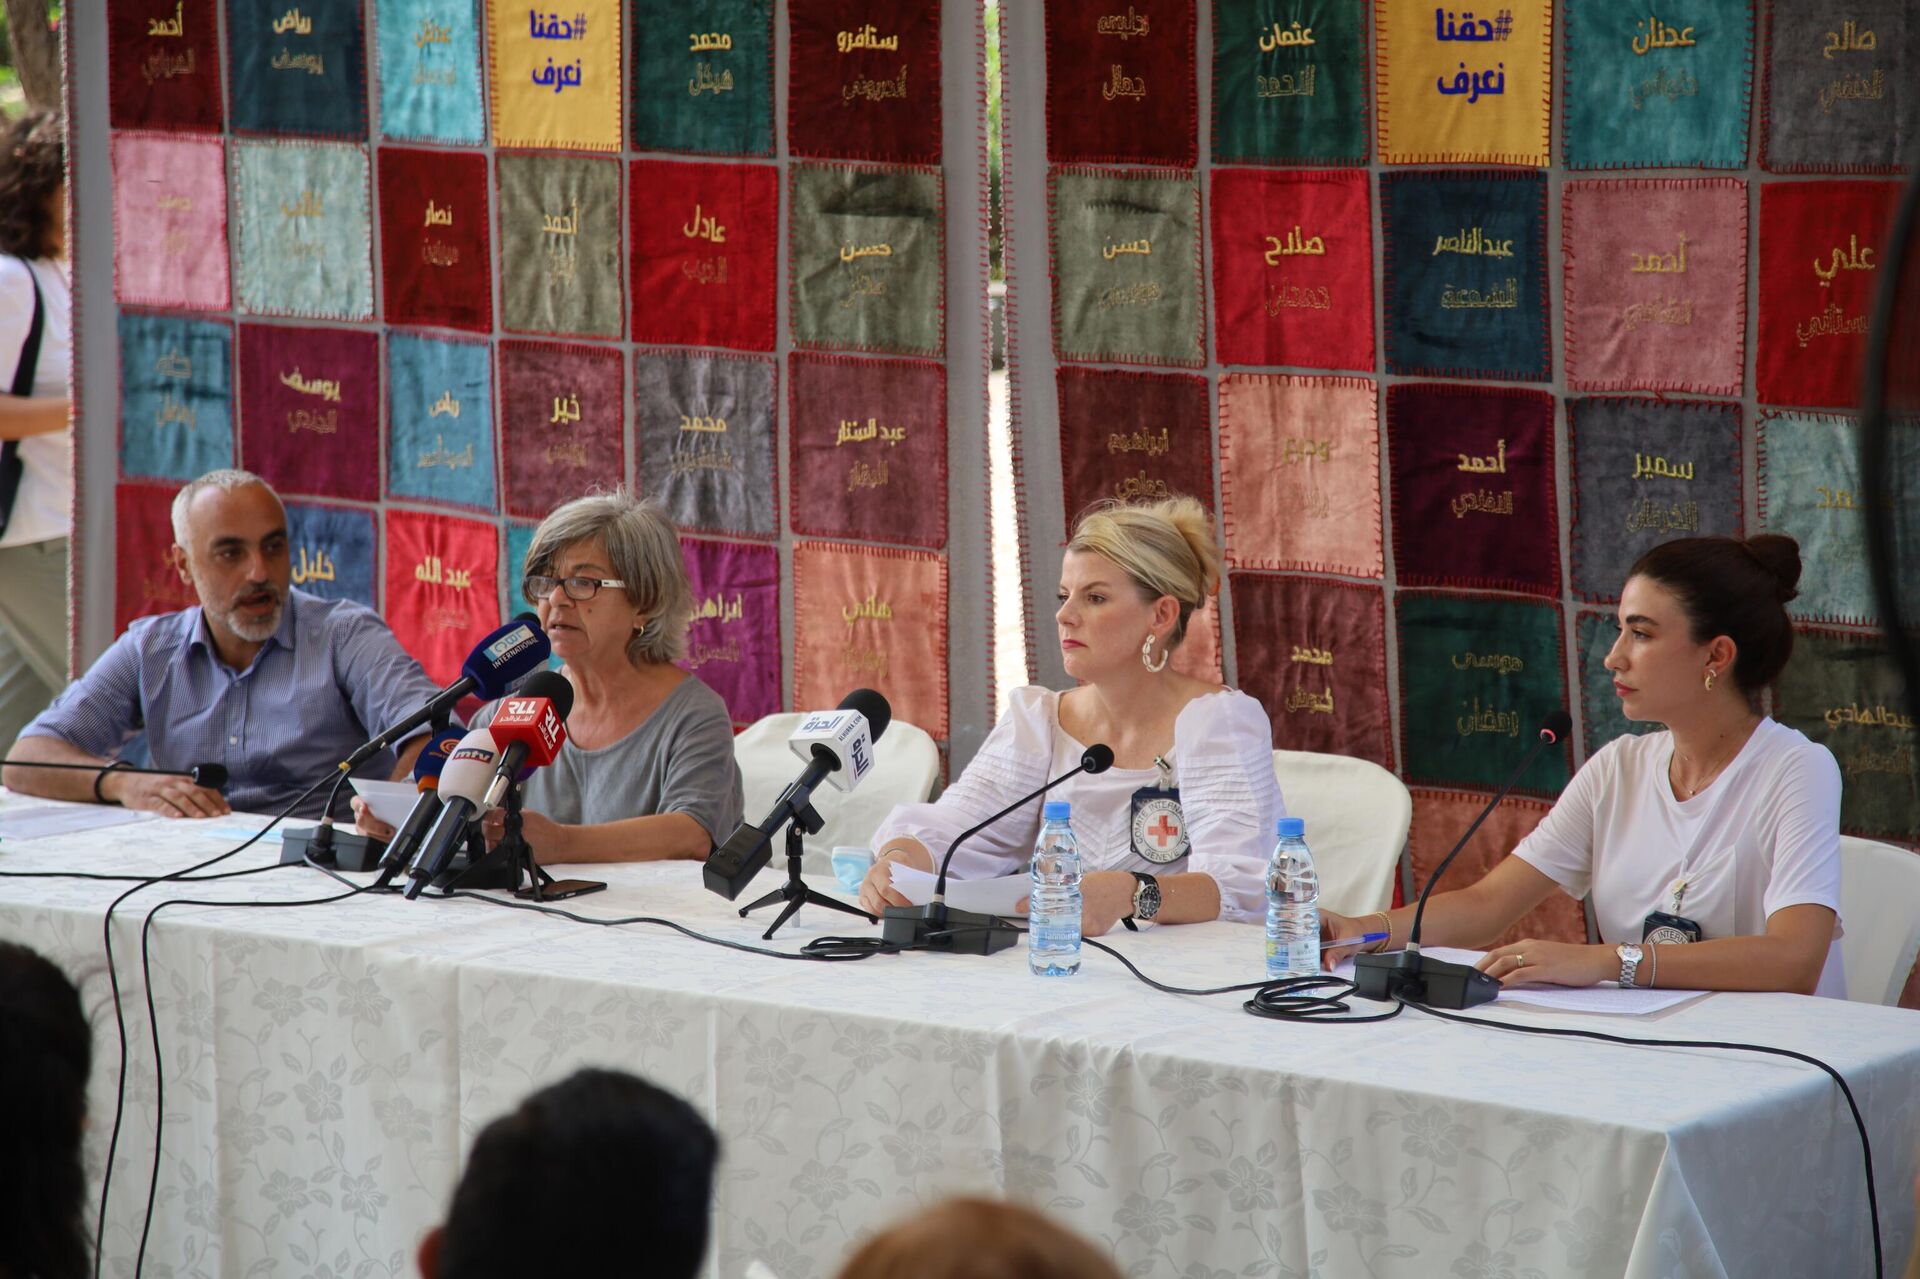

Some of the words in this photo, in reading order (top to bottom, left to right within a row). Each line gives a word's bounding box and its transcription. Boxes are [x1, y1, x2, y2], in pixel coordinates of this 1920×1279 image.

[148, 1, 183, 37] أحمد
[1259, 21, 1316, 51] عثمان
[1632, 16, 1697, 56] عدنان
[689, 31, 732, 51] محمد
[1823, 20, 1877, 60] صالح
[532, 57, 581, 93] نعرف
[1437, 62, 1504, 104] نعرف
[542, 195, 578, 234] أحمد
[683, 204, 726, 243] عادل
[840, 240, 893, 262] حسن
[1103, 235, 1153, 260] حسن
[1264, 225, 1326, 266] صلاح
[1631, 230, 1687, 273] أحمد
[1814, 234, 1877, 288] علي
[279, 366, 341, 402] يوسف
[681, 415, 727, 432] محمد
[880, 424, 906, 447] عبد
[1457, 439, 1506, 474] أحمد
[1632, 452, 1695, 480] سمير
[291, 547, 336, 584] خليل
[415, 555, 442, 584] الله
[445, 568, 471, 592] عبد
[492, 636, 539, 669] INTERNATIONAL
[1291, 645, 1334, 666] محمد
[508, 700, 536, 715] RLL
[545, 705, 560, 744] RLL
[802, 716, 844, 733] الحرة
[1456, 697, 1519, 737] رمضان
[455, 750, 491, 762] mtv
[851, 733, 870, 777] الحرة
